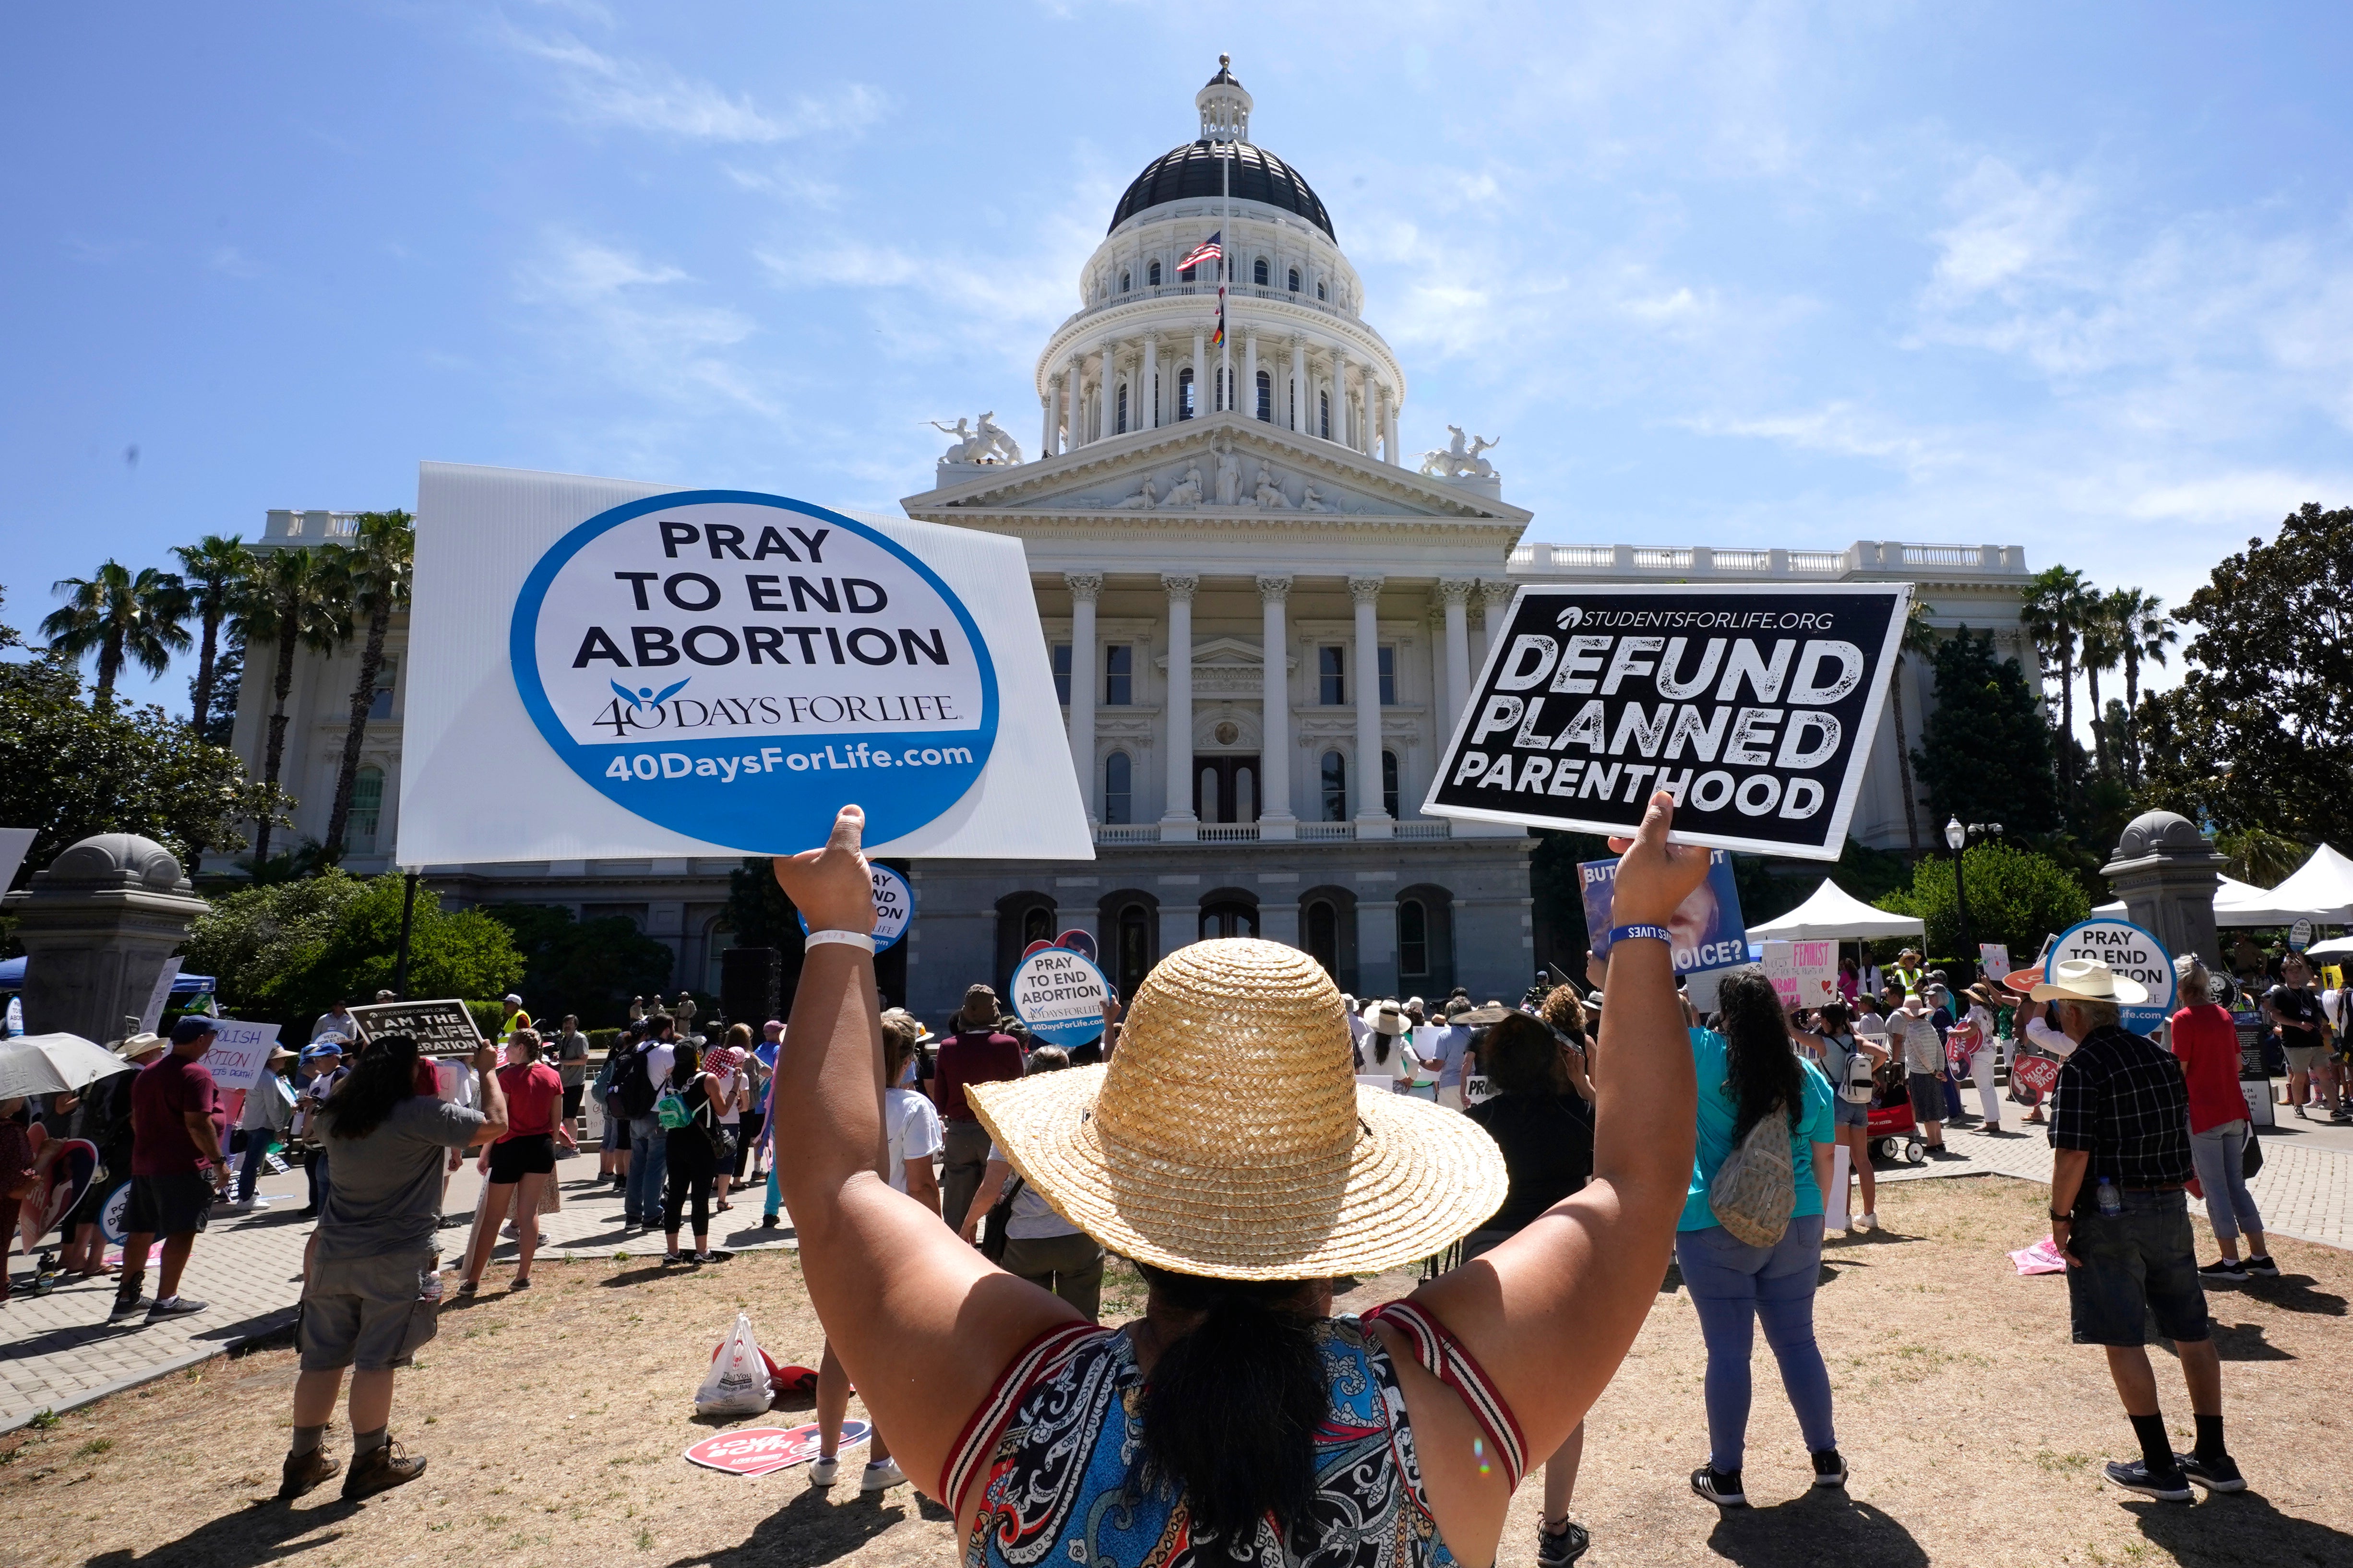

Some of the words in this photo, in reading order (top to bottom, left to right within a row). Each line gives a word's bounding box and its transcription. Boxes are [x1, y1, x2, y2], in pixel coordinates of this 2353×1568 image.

[659, 522, 830, 563] PRAY
[615, 572, 721, 612] TO
[745, 575, 888, 614] END
[1582, 610, 1834, 630] STUDENTSFORLIFE.ORG
[572, 626, 950, 669] ABORTION
[1494, 634, 1864, 705] DEFUND
[592, 695, 667, 737] 40
[673, 698, 782, 728] DAYS
[1470, 694, 1842, 769] PLANNED
[605, 742, 974, 783] 40DaysForLife.com
[1453, 751, 1825, 820] PARENTHOOD
[872, 874, 893, 887] AY
[1584, 865, 1616, 883] BUT
[872, 889, 896, 903] ND
[1628, 927, 1657, 938] LIVES
[2083, 931, 2133, 945] PRAY
[1035, 956, 1073, 972] PRAY
[1671, 939, 1743, 972] OICE?
[2070, 949, 2097, 960] TO
[2104, 950, 2147, 964] END
[1027, 974, 1050, 988] TO
[1054, 971, 1087, 985] END
[2018, 974, 2044, 985] LO
[2112, 968, 2162, 984] TION
[1022, 985, 1102, 1005] ABORTION
[377, 1008, 450, 1017] STUDENTSFORLIFE.ORG
[1042, 1009, 1063, 1019] DAYS
[366, 1020, 374, 1030] I
[384, 1017, 415, 1028] AM
[420, 1013, 461, 1025] THE
[216, 1028, 262, 1045] OLISH
[417, 1040, 479, 1052] ERATION
[2024, 1062, 2049, 1082] BOTH
[2036, 1068, 2058, 1088] LOVE
[706, 1441, 794, 1458] BOTH
[707, 1434, 786, 1450] LOVE
